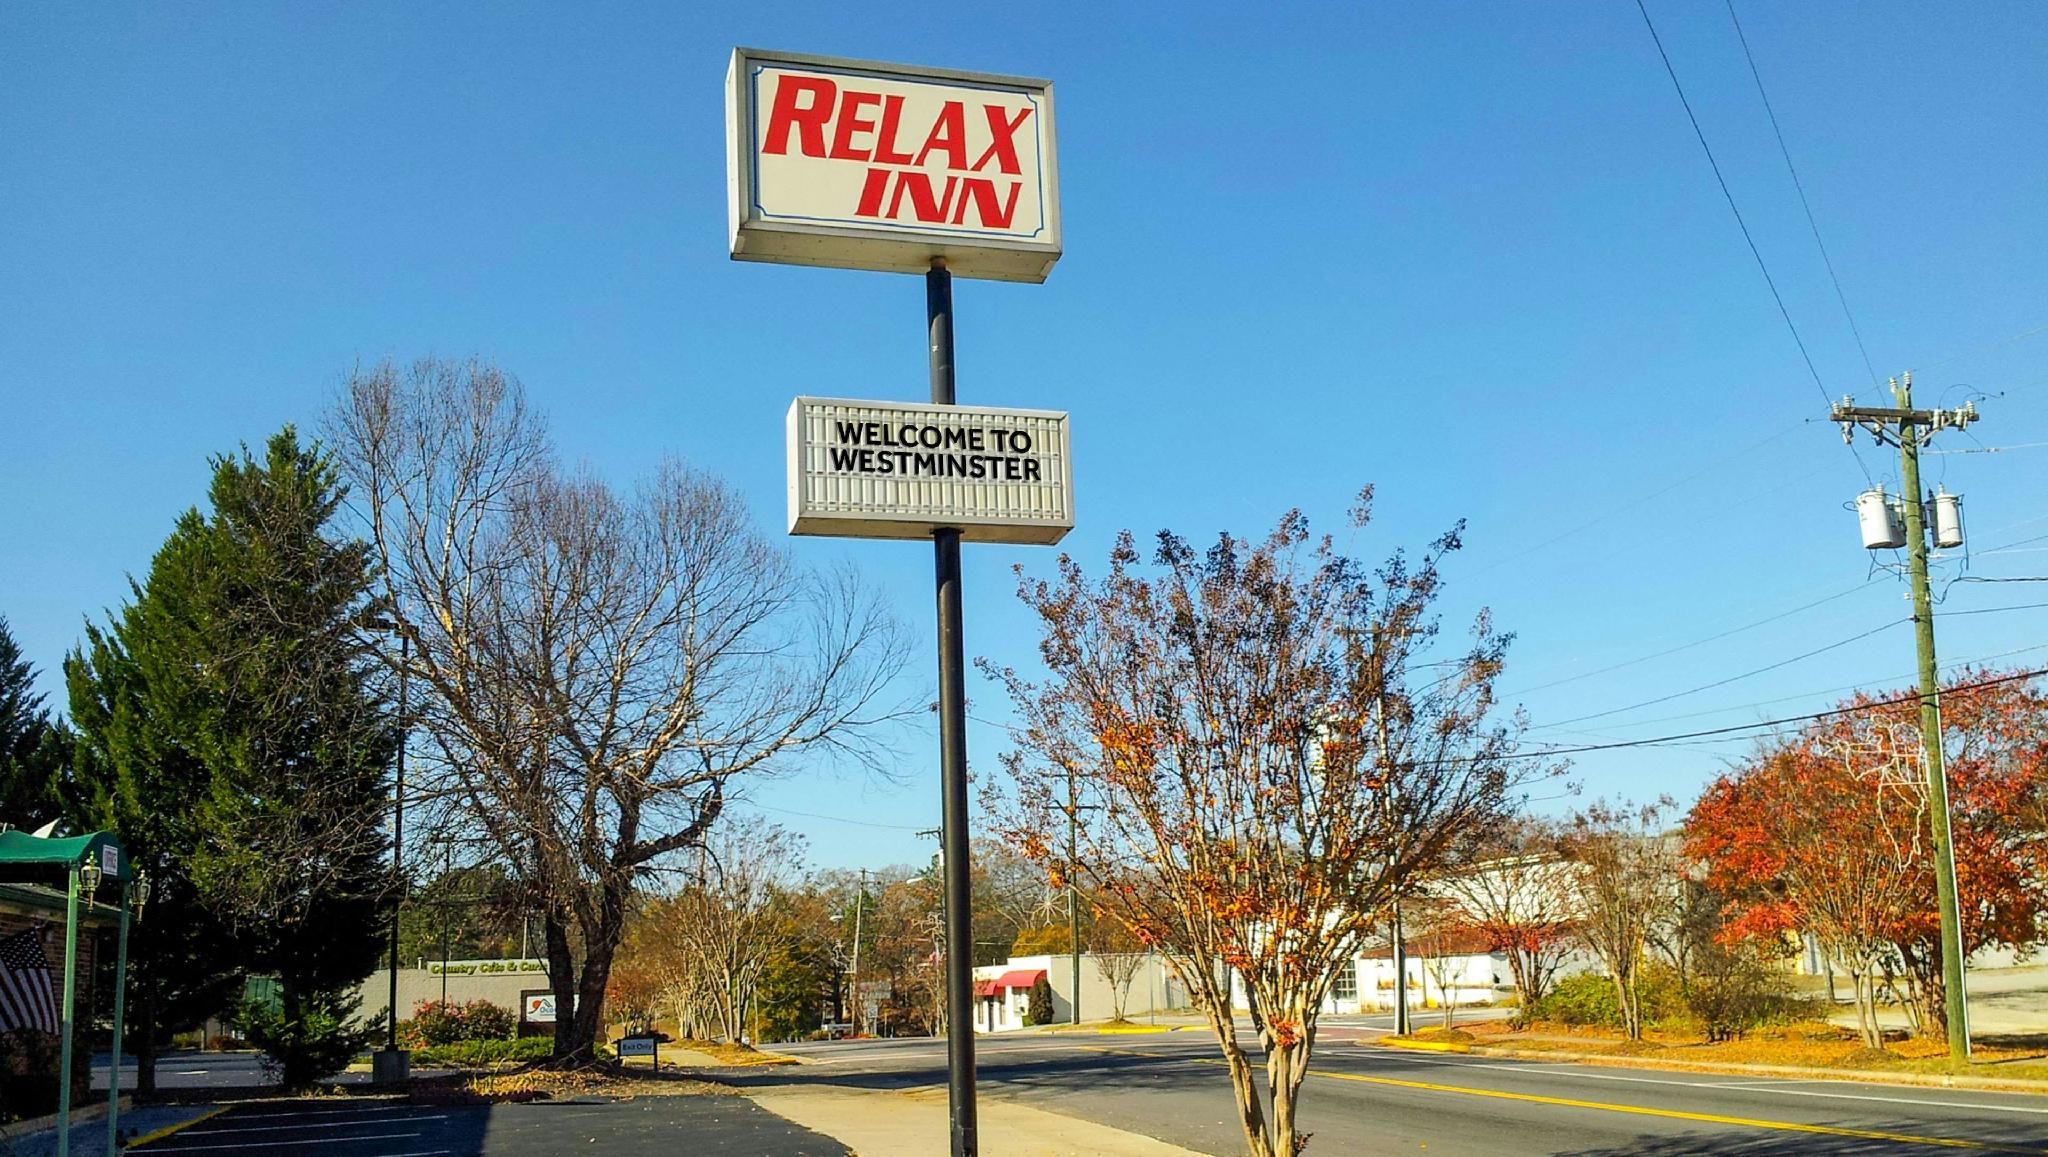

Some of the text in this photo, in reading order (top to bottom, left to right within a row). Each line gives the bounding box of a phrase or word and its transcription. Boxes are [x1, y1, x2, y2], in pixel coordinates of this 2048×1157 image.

[762, 74, 1034, 176] RELAX
[855, 167, 1022, 229] INN
[837, 421, 1032, 454] WELCOME TO
[830, 447, 1041, 481] WESTMINSTER
[431, 963, 478, 975] Country
